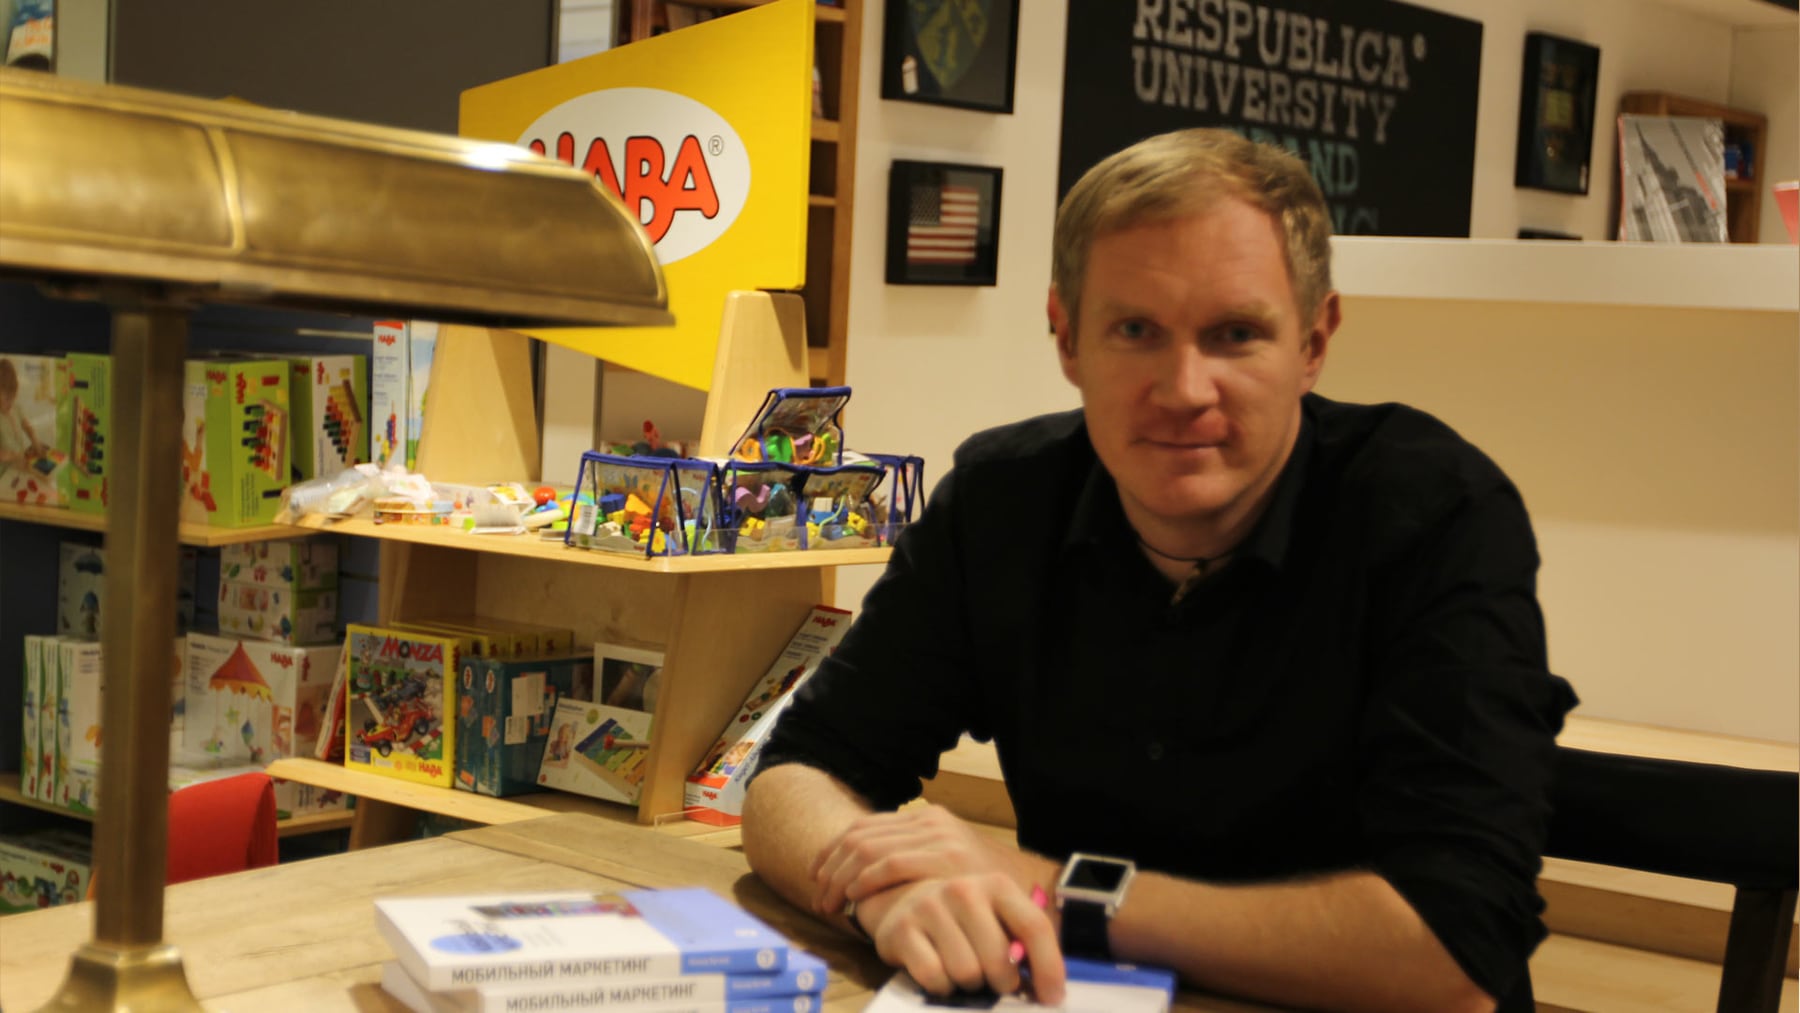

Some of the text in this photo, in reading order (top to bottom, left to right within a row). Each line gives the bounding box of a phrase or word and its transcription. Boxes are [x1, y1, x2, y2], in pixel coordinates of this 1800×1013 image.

[1132, 0, 1409, 89] RESPUBLICA
[1131, 46, 1397, 144] UNIVERSITY
[380, 634, 445, 664] MONZA
[451, 957, 649, 985] МОБИЛЬНЫЙ МАРКЕТИНГ
[505, 983, 697, 1012] МОБИЛЬНЫЙ МАРКЕТИНГ
